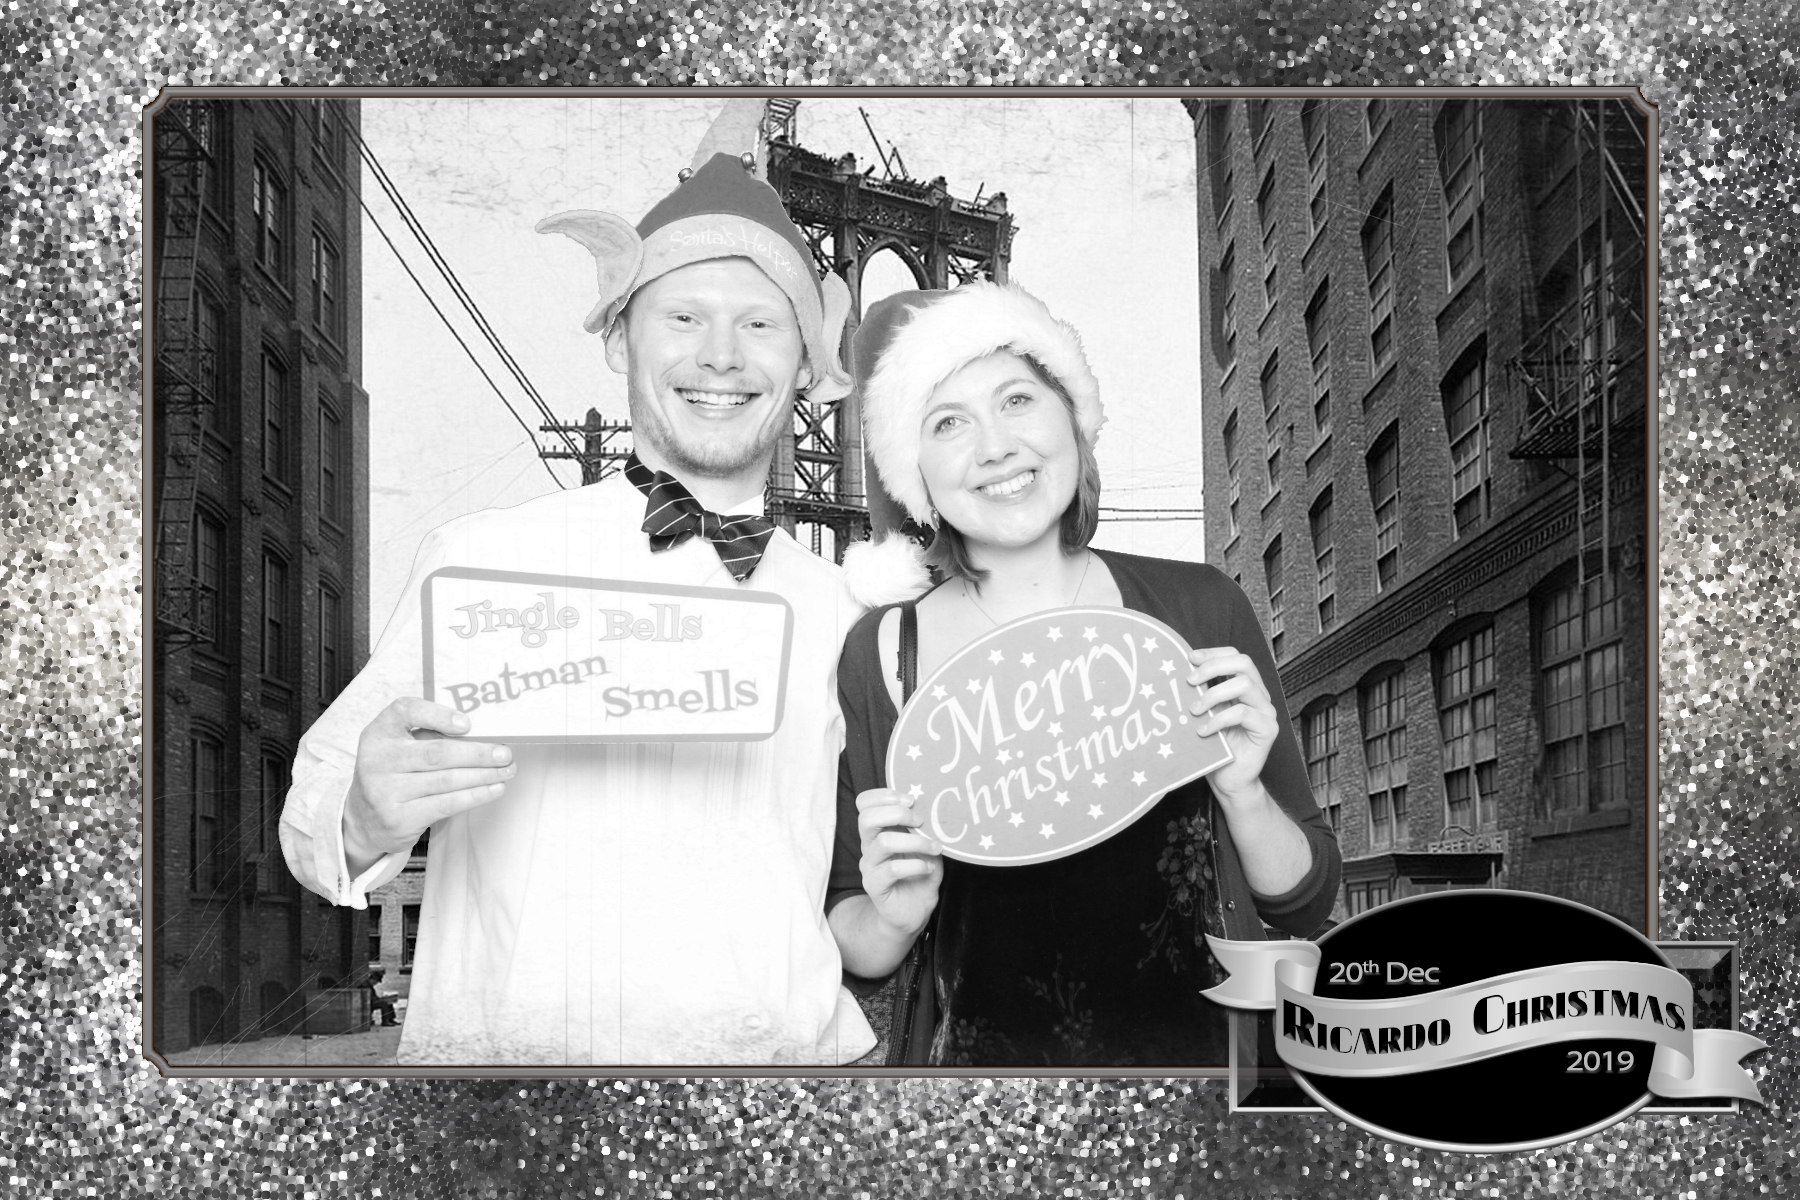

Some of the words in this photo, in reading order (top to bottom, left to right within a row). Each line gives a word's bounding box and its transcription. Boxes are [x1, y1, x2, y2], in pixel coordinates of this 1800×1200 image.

[669, 225, 736, 252] Santa's
[448, 592, 580, 648] Jingle
[598, 603, 703, 643] Bells
[442, 655, 613, 714] Batman
[601, 669, 760, 722] Smells
[926, 633, 1138, 774] Merry
[930, 678, 1189, 844] Christmas!
